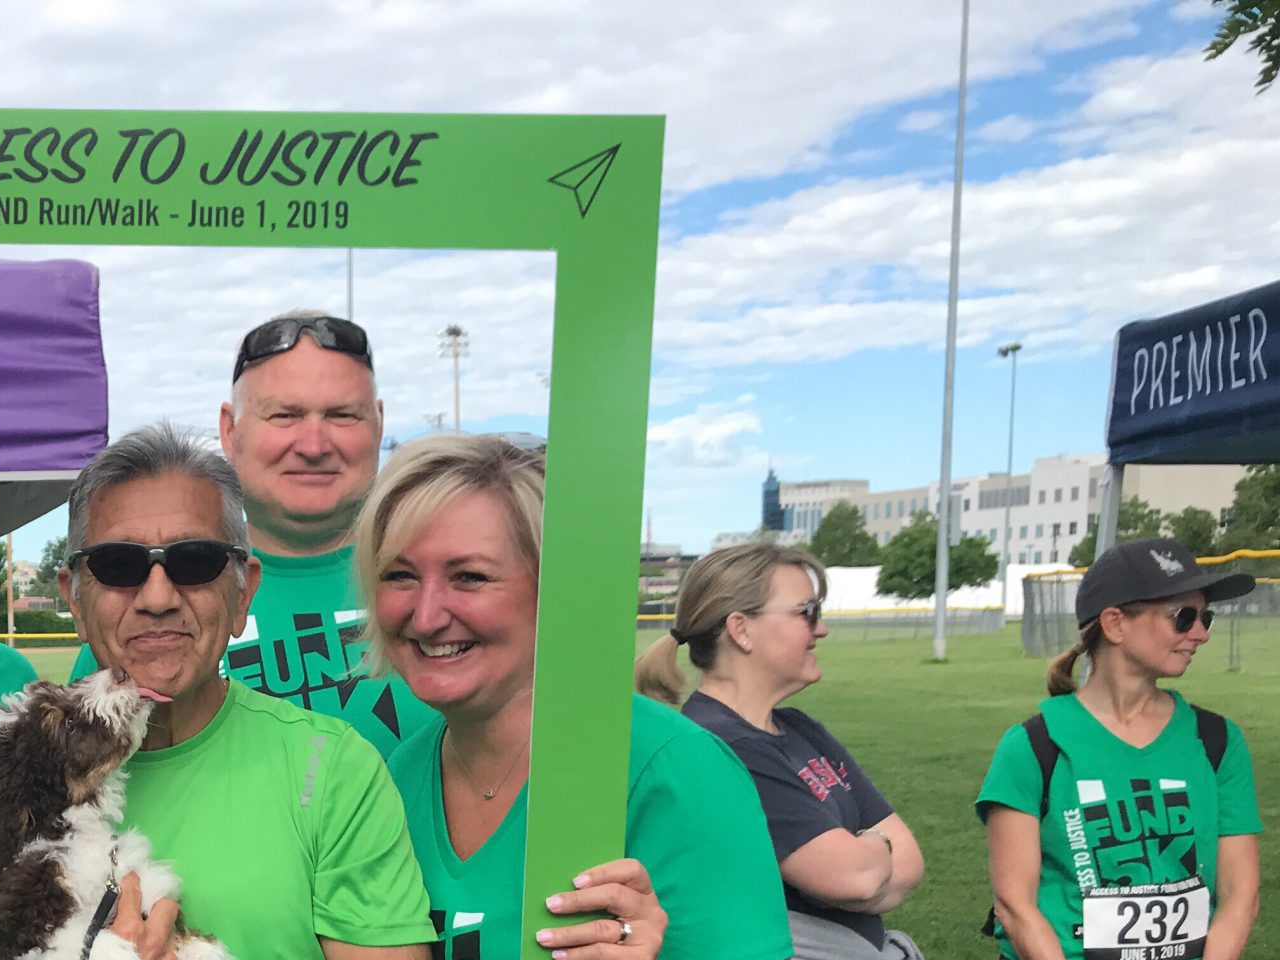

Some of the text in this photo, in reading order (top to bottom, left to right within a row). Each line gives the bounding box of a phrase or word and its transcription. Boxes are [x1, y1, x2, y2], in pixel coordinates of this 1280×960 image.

[111, 127, 186, 186] TO
[199, 127, 440, 188] JUSTICE
[39, 197, 159, 227] Run/Walk
[187, 200, 245, 228] June
[256, 201, 276, 232] 1,
[287, 201, 349, 230] 2019
[1130, 308, 1268, 416] PREMIER
[1084, 795, 1194, 848] FUND
[1073, 851, 1091, 866] TO
[1117, 896, 1190, 945] 232
[1119, 943, 1186, 960] JUNE 1, 2019
